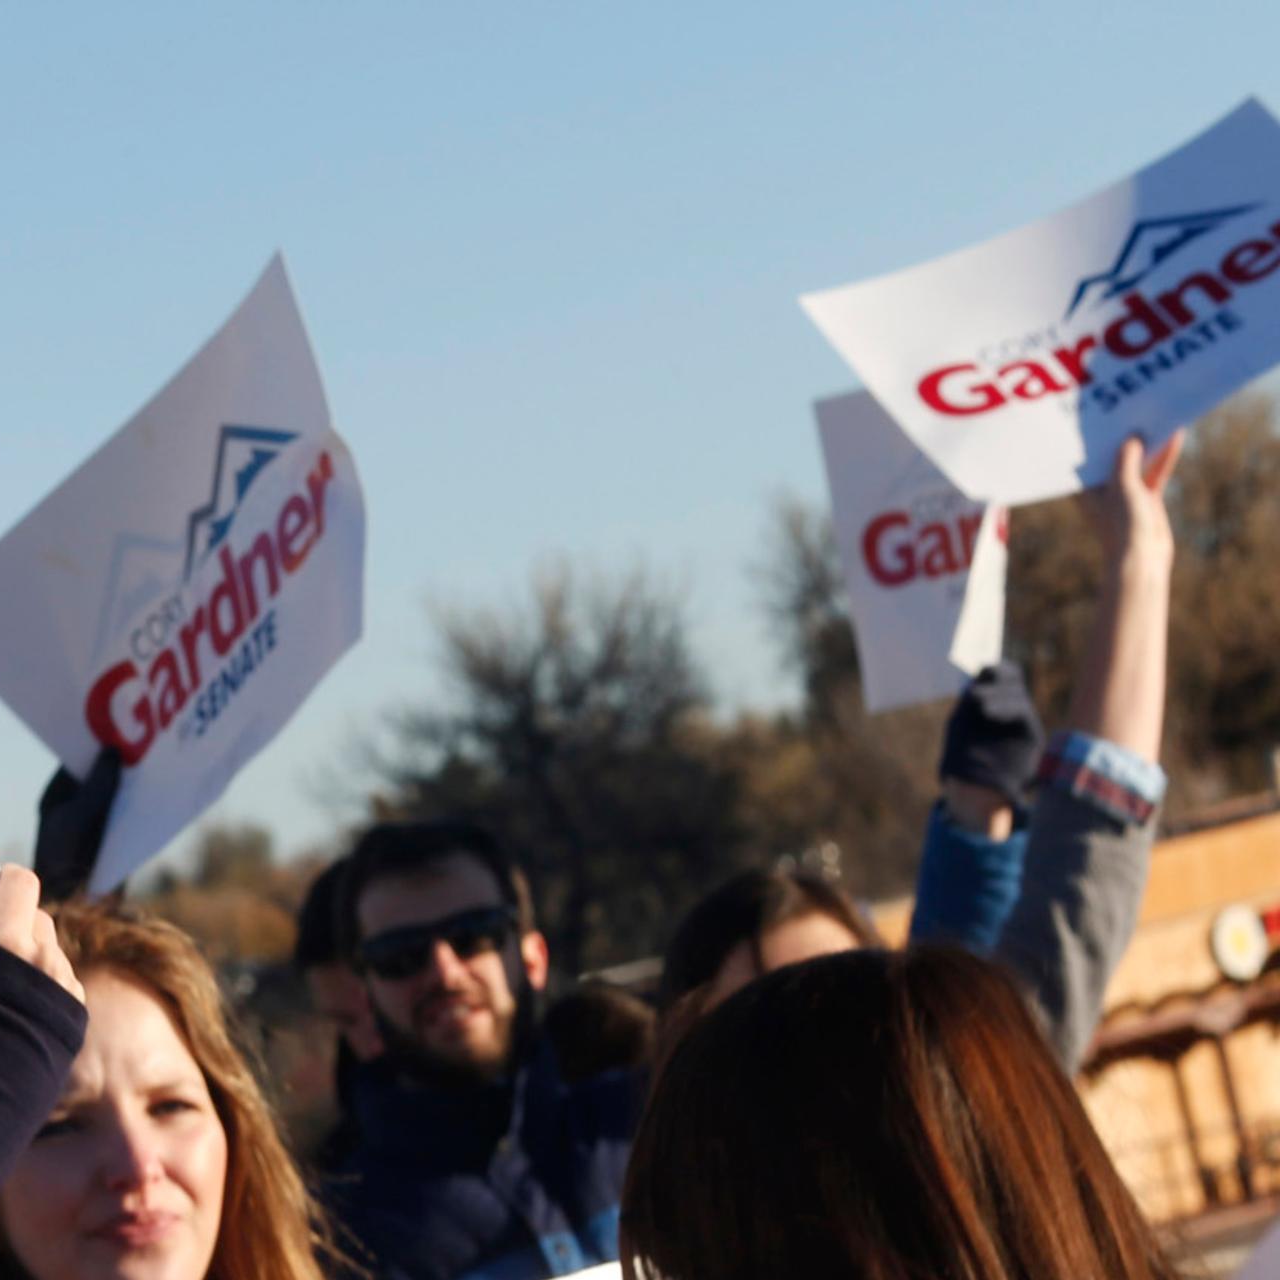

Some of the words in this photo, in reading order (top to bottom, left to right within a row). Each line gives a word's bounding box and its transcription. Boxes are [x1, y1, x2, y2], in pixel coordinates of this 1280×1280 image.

[1091, 309, 1244, 412] SENATE
[84, 450, 334, 768] Gardner
[194, 607, 277, 737] SENATE
